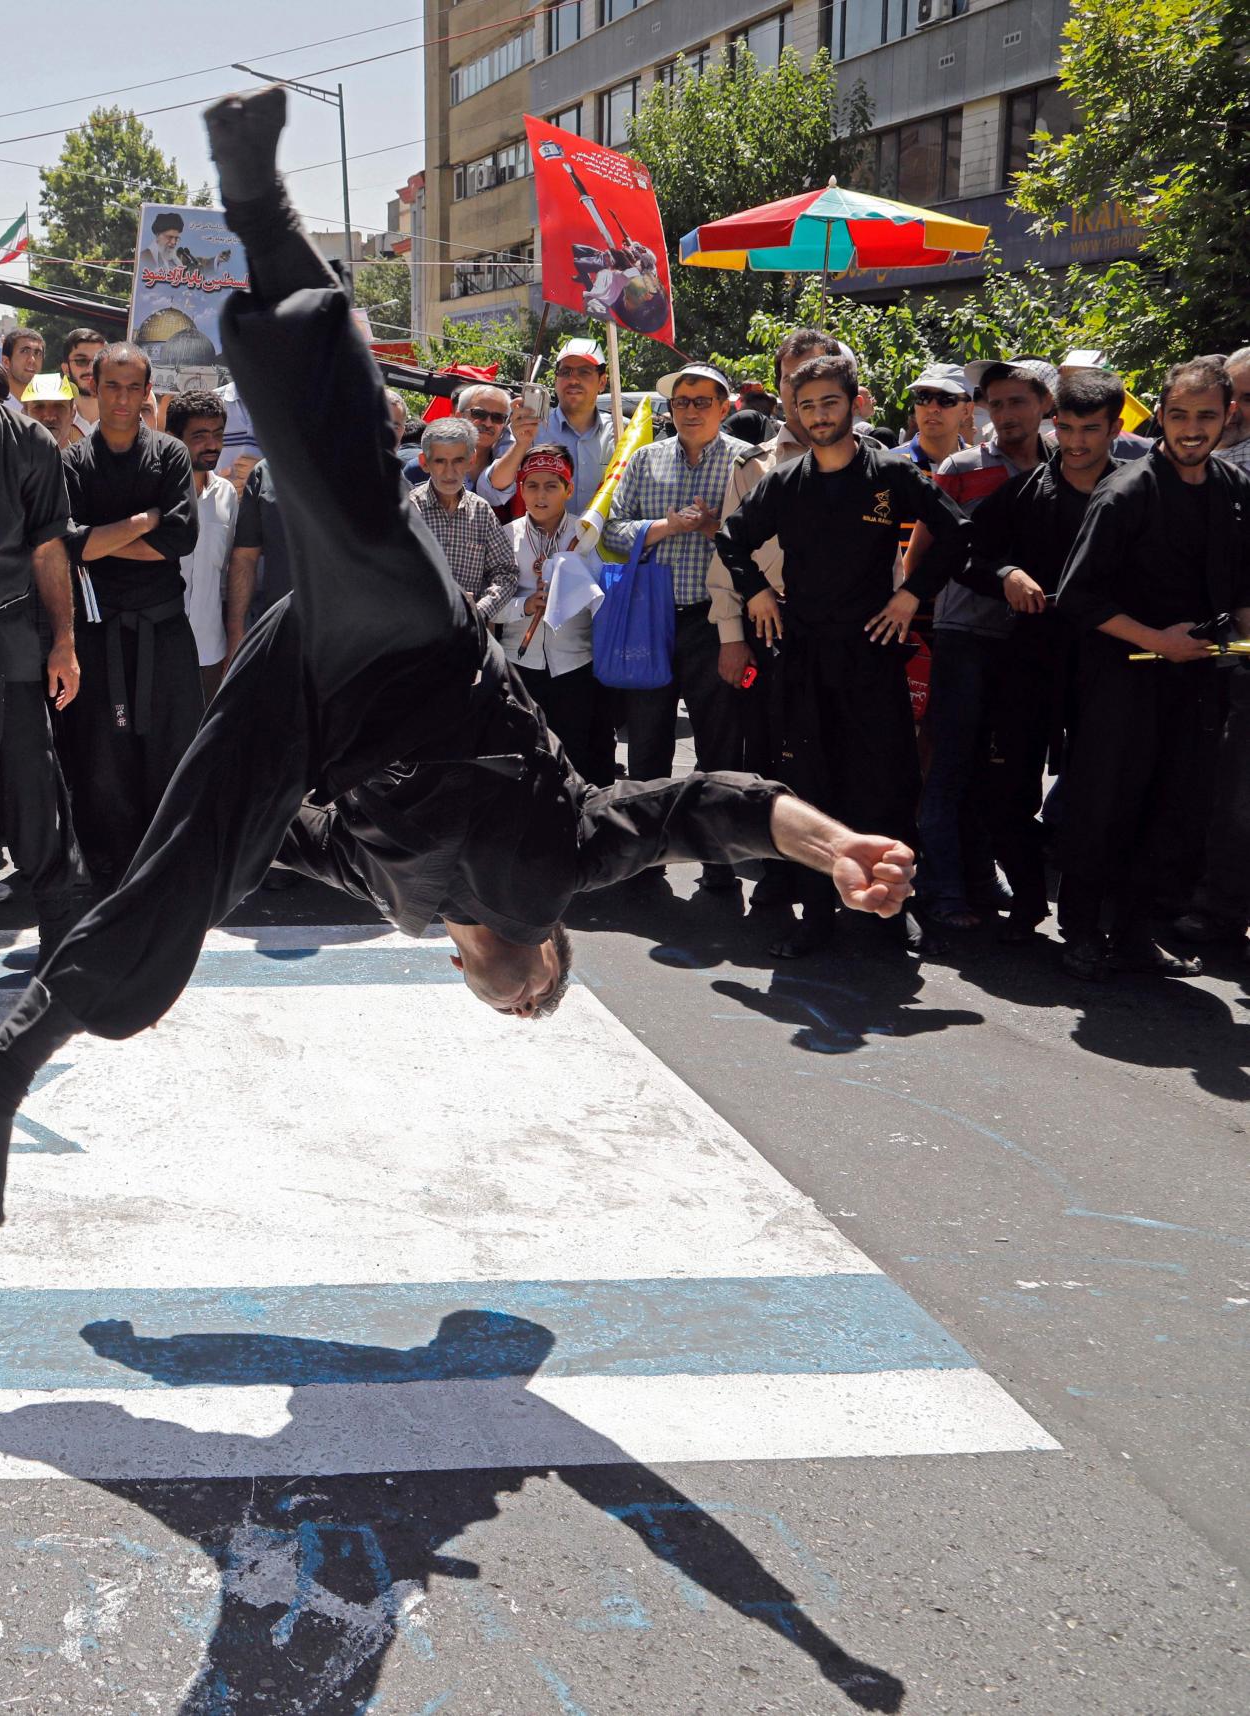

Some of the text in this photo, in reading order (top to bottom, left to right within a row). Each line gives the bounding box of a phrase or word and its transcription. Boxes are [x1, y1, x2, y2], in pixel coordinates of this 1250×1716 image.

[142, 268, 166, 287] شود
[166, 264, 185, 286] آزاد
[184, 270, 203, 288] باید
